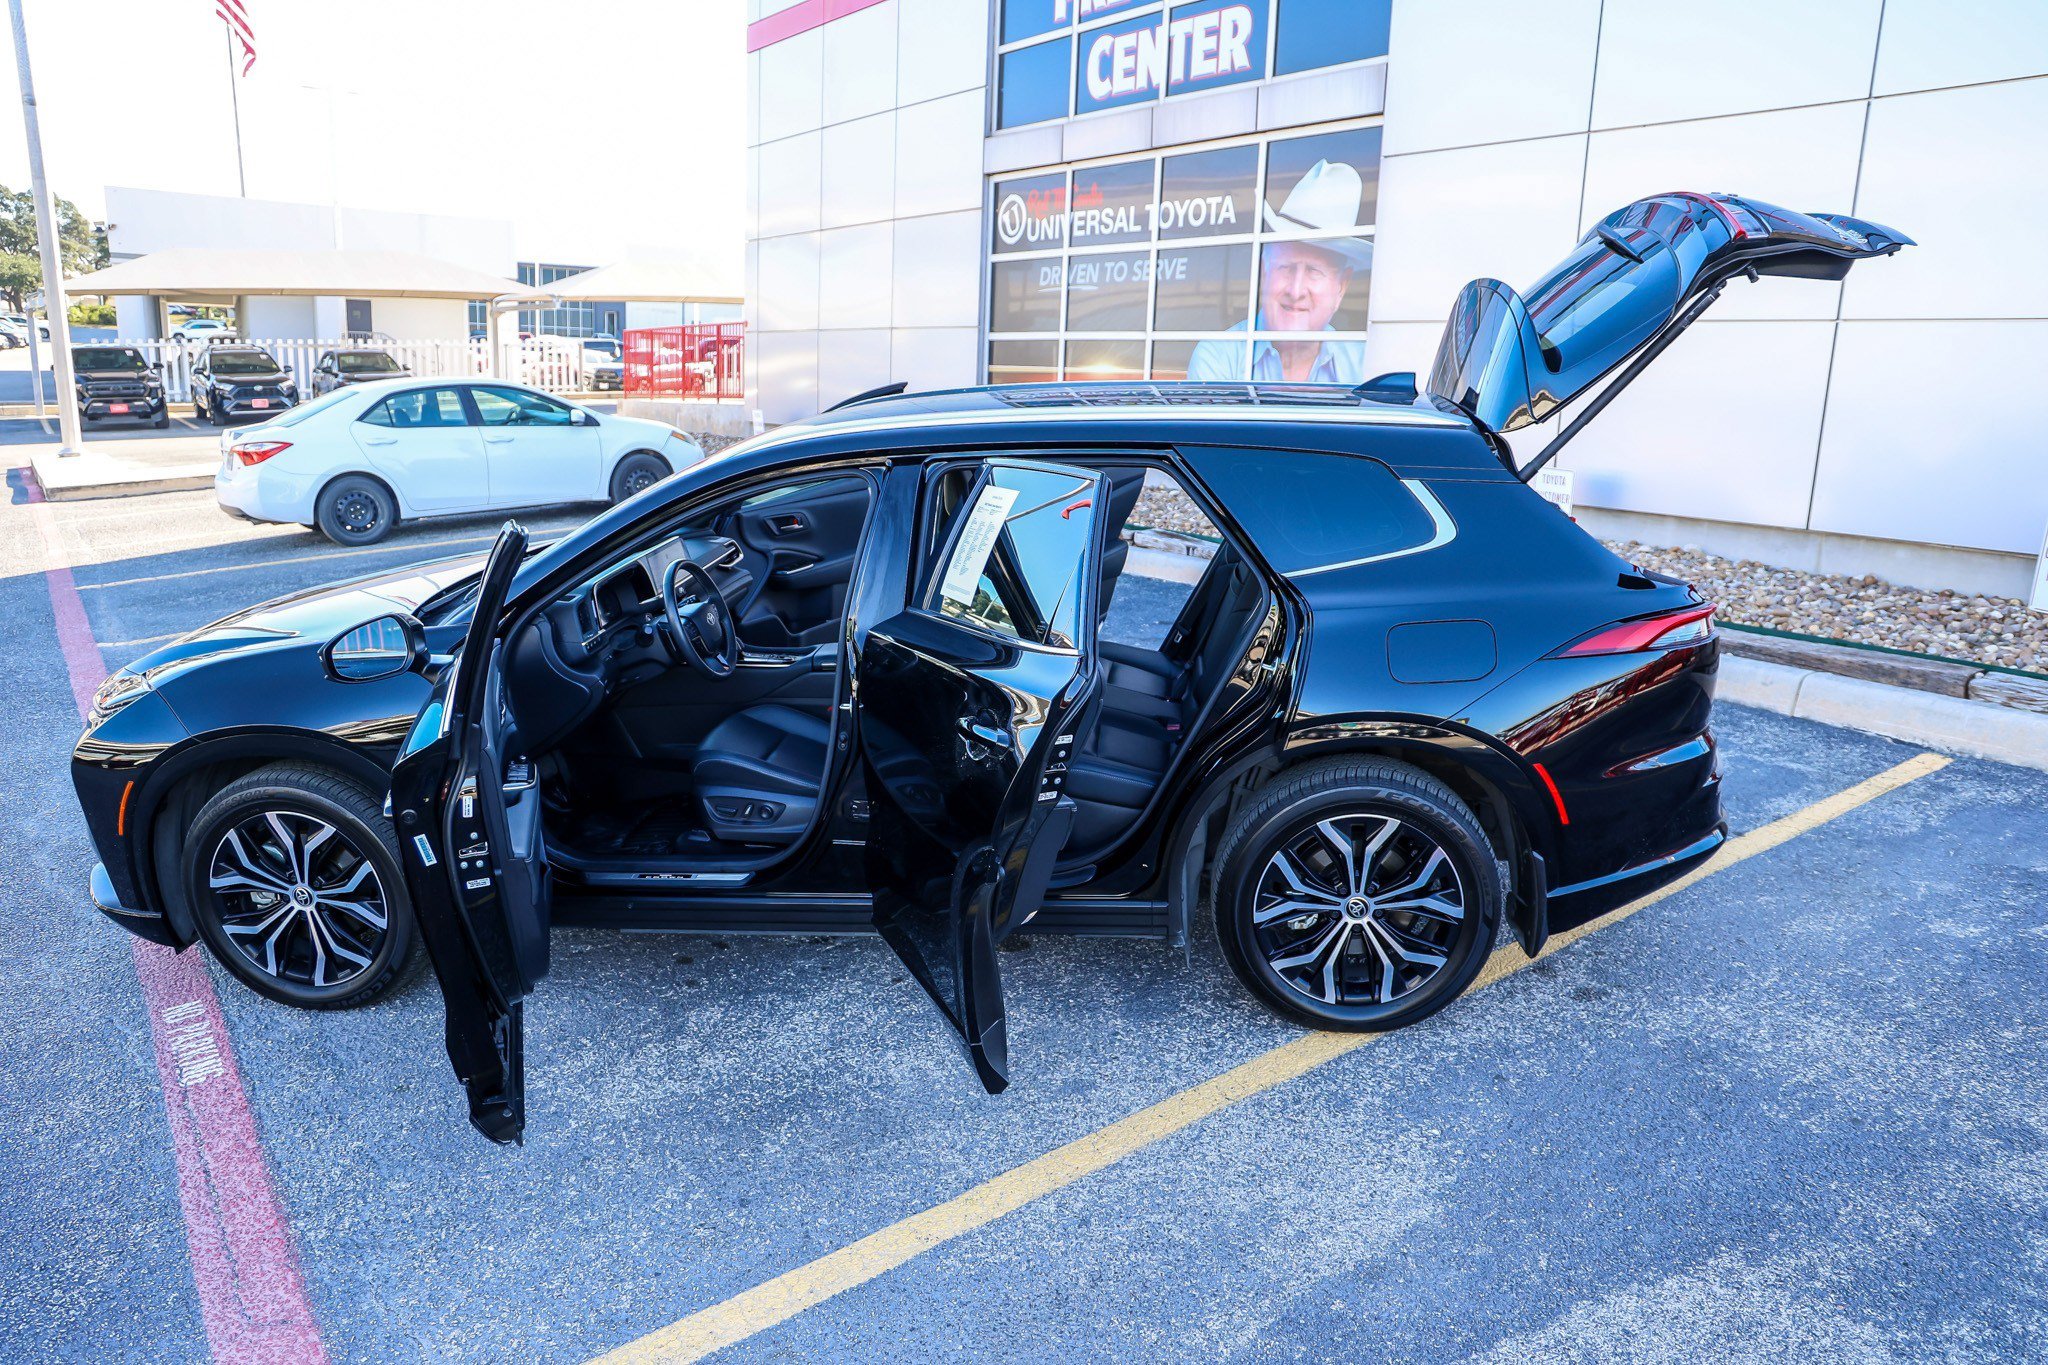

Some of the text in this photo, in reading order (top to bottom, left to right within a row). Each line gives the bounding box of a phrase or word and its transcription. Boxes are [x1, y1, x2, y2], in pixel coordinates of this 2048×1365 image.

[1086, 5, 1252, 100] CENTER
[1027, 195, 1236, 242] UNIVERSAL TOYOTA
[1039, 257, 1188, 286] DRVEN TO SERVE
[1542, 473, 1566, 486] TOYOTA
[1541, 490, 1570, 504] STOMER
[162, 1000, 206, 1024] NO
